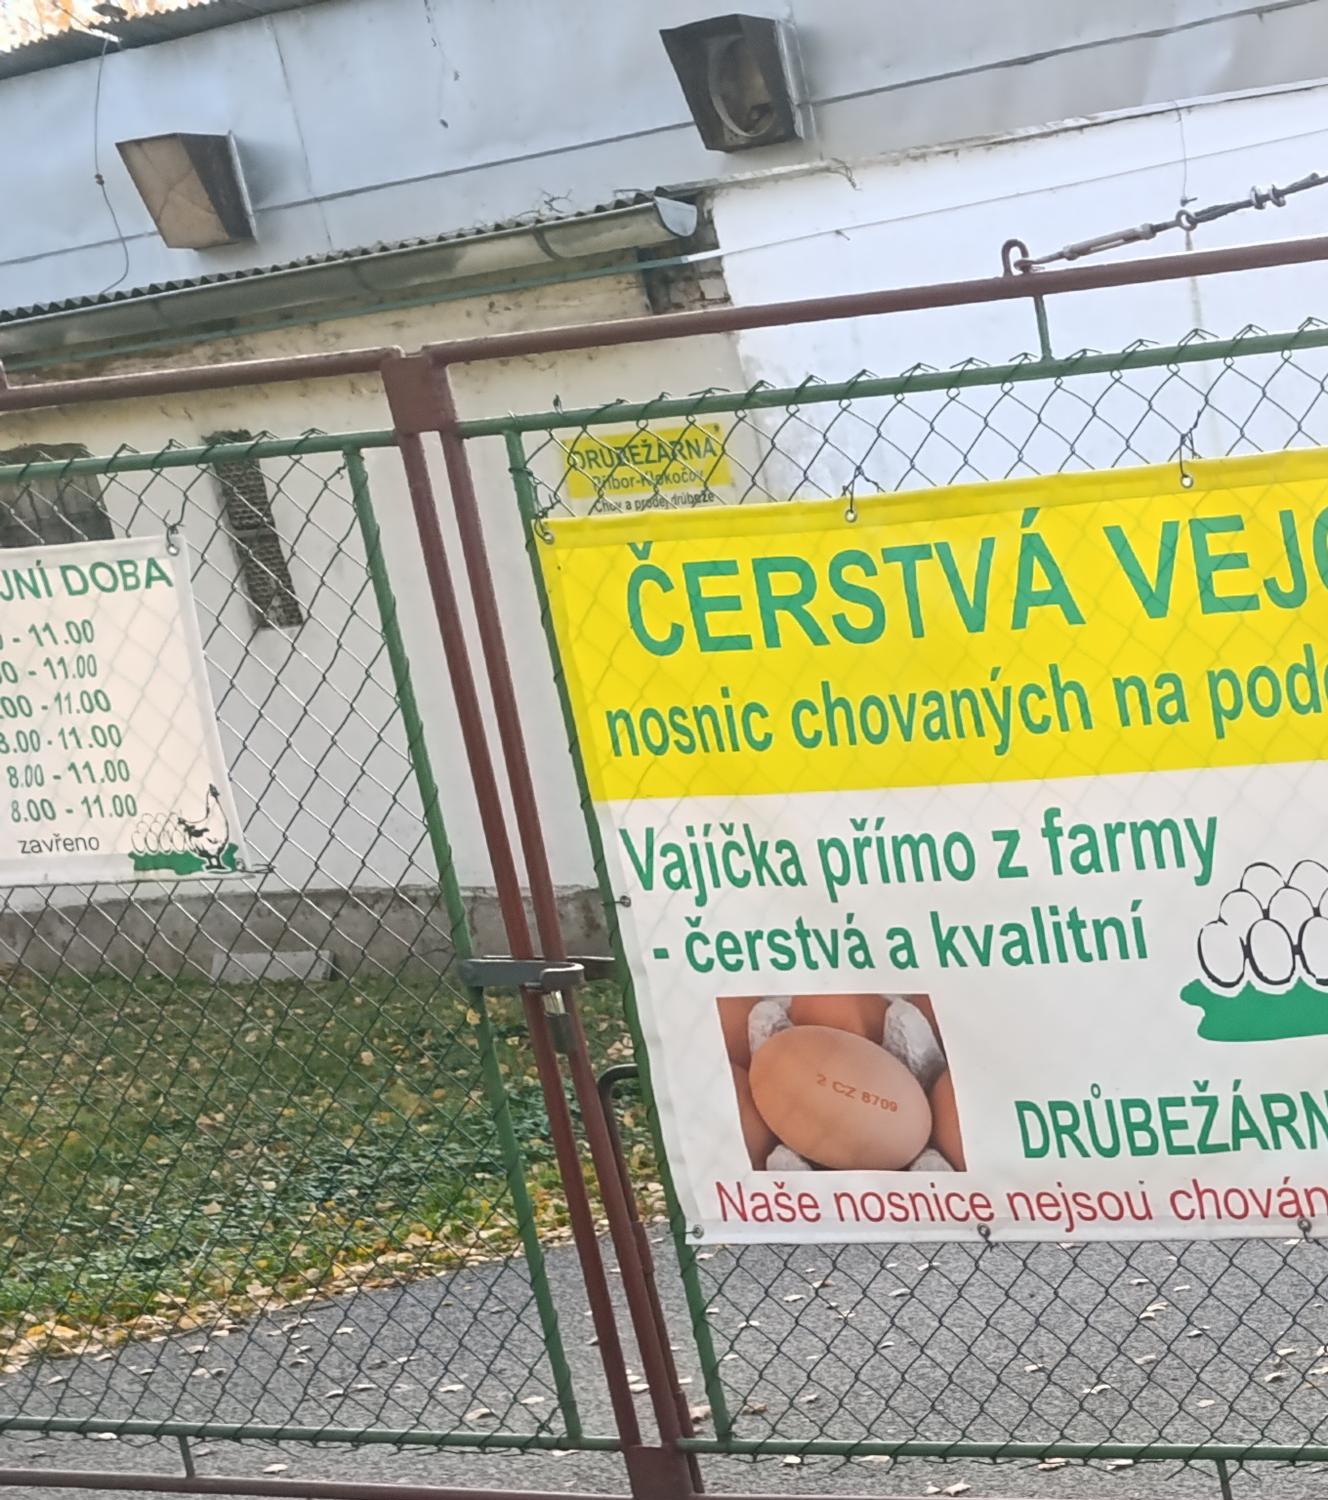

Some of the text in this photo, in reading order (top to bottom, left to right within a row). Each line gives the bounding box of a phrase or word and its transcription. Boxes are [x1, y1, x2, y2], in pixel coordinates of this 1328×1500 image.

[626, 501, 632, 511] a
[59, 557, 173, 597] DOBA
[627, 507, 1085, 656] ČERSTVÁ
[28, 619, 94, 647] 11.00
[0, 660, 18, 684] 0
[43, 654, 97, 680] 11.00
[54, 689, 111, 715] 11.00
[606, 687, 773, 757] nosnic
[791, 664, 1094, 756] chovaných
[1112, 671, 1188, 728] na
[58, 724, 122, 750] 11.00
[6, 763, 45, 789] 8.00
[68, 759, 130, 784] 11.00
[11, 798, 56, 823] 8.00
[81, 794, 137, 819] 11.00
[17, 834, 100, 855] zavřeno
[620, 807, 1217, 907] Vajíčka přímo z farmy
[685, 912, 874, 973] čerstvá
[887, 927, 918, 970] a
[930, 899, 1149, 968] kvalitní
[816, 1073, 826, 1087] 2
[832, 1081, 856, 1099] CZ
[715, 1181, 821, 1223] Naše
[834, 1183, 994, 1222] nosnice
[1007, 1181, 1153, 1233] nejsou
